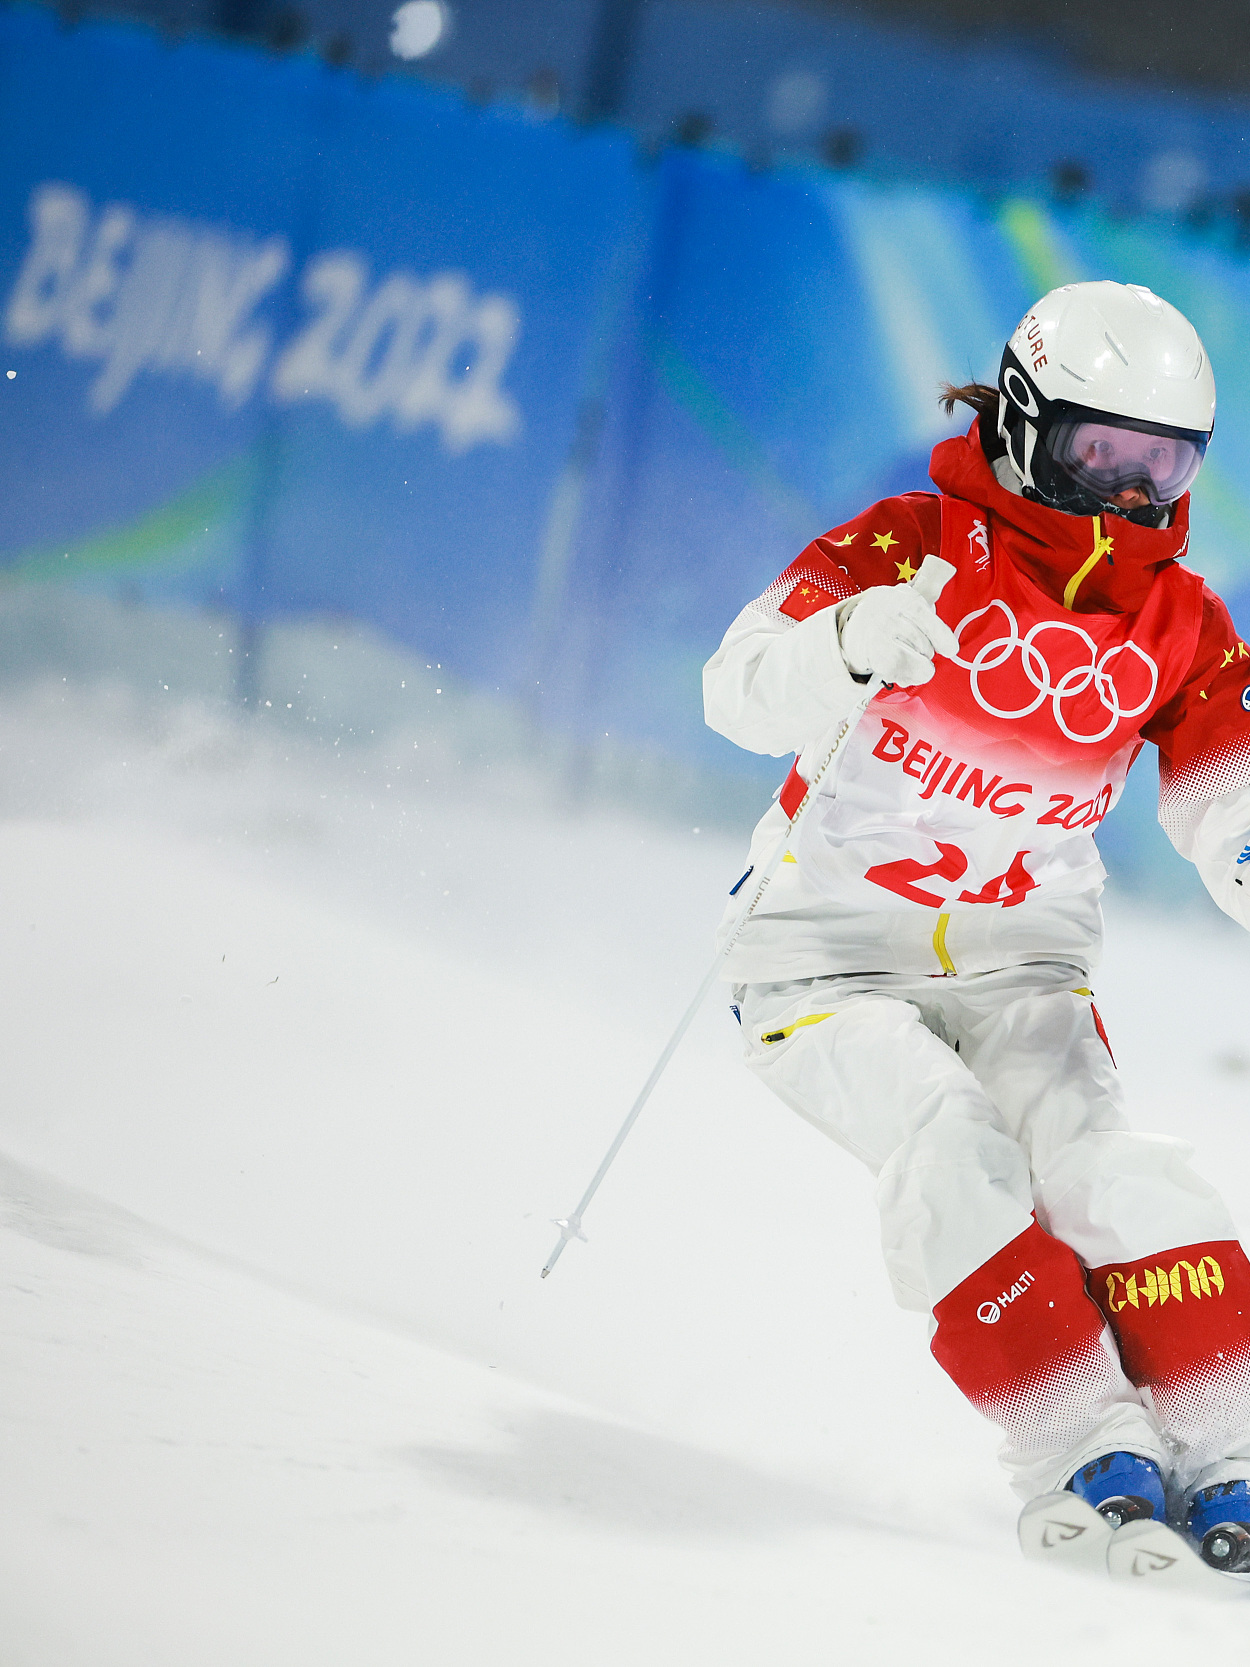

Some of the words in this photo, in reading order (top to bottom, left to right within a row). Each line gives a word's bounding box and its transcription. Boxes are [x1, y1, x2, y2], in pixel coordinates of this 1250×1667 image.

[871, 717, 1033, 820] BEIJING
[864, 839, 1042, 909] 24
[997, 1270, 1036, 1308] HALTI
[1105, 1255, 1225, 1313] CHINA
